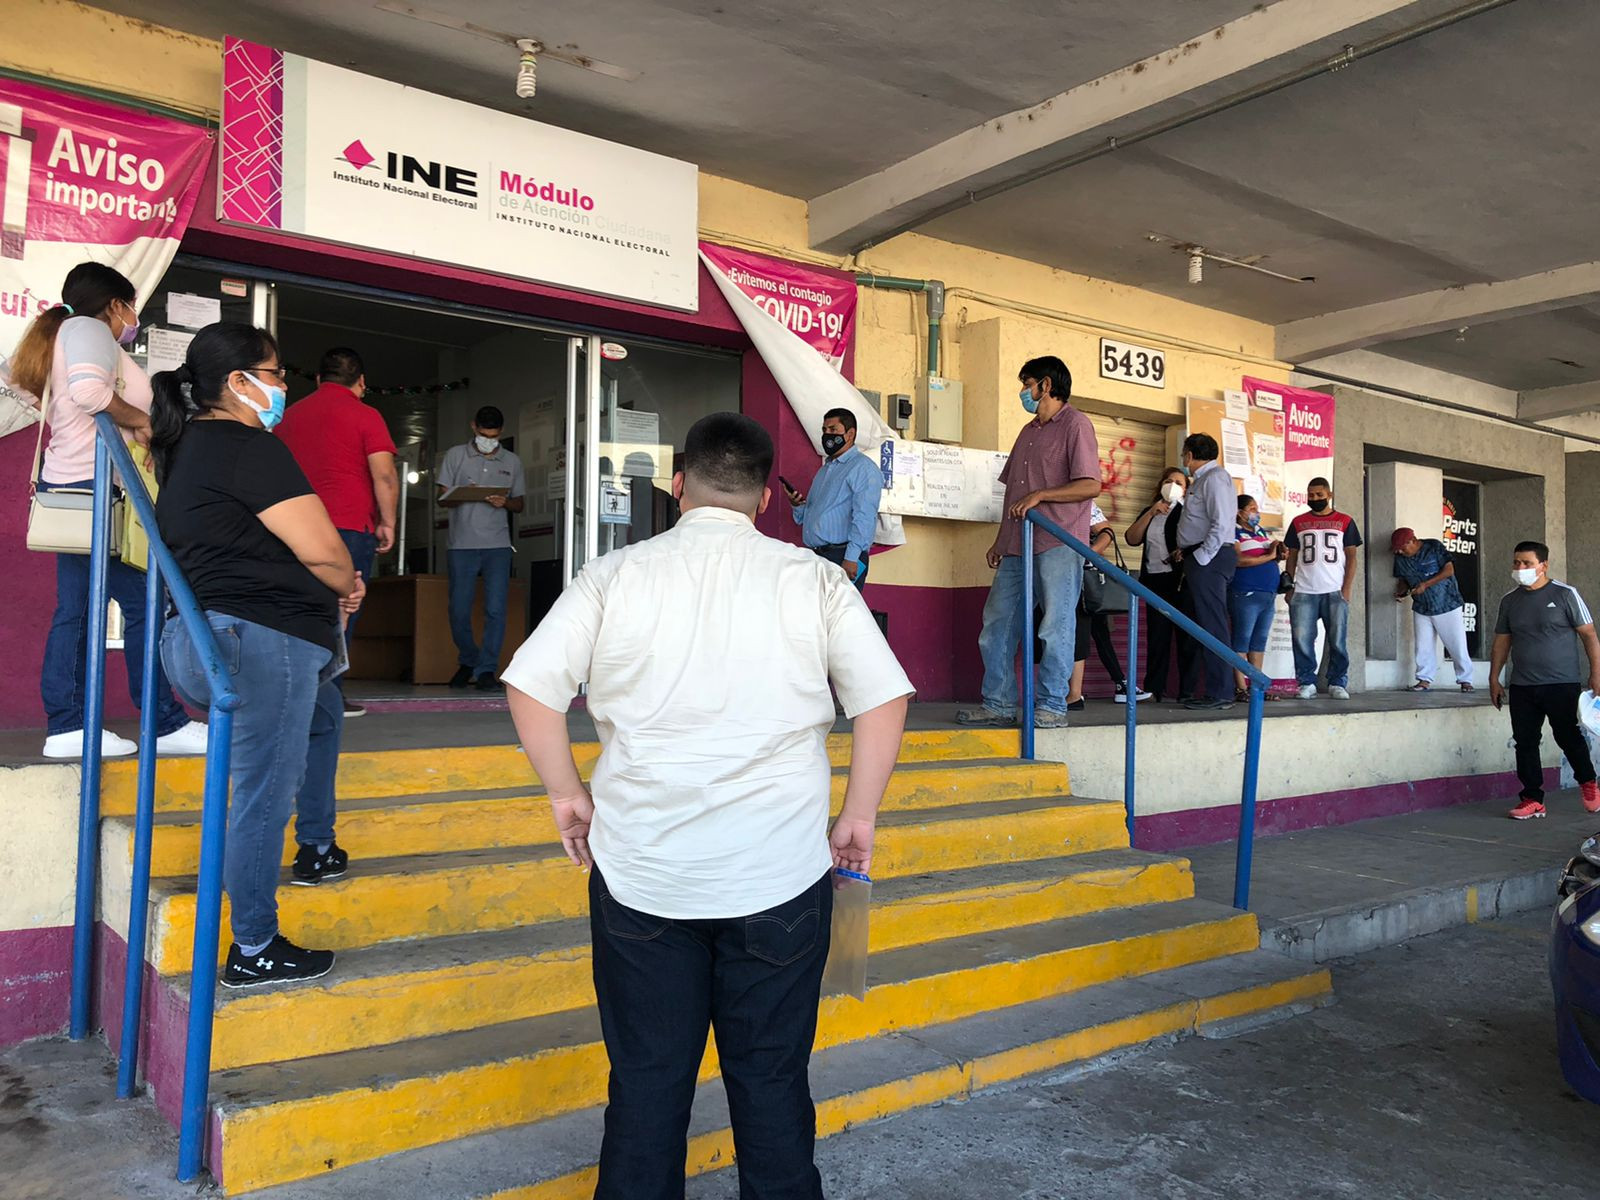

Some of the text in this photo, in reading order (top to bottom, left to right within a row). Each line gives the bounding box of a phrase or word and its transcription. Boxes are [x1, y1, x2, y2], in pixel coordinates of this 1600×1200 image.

[47, 127, 165, 192] Aviso
[387, 151, 477, 198] INE
[333, 171, 477, 210] Instituto Nacional Electoral
[500, 170, 594, 211] Módulo
[496, 212, 671, 257] INSTITUTO NACIONAL ELECTORAL
[499, 194, 672, 244] de Atención Ciudadana
[779, 281, 788, 295] el
[790, 286, 832, 307] contagio
[1104, 345, 1164, 381] 5439
[1289, 402, 1322, 431] Aviso
[1288, 427, 1330, 449] importante
[1287, 491, 1308, 508] segu
[1443, 514, 1478, 536] Parts
[1302, 532, 1338, 564] 85
[1443, 536, 1476, 554] aster
